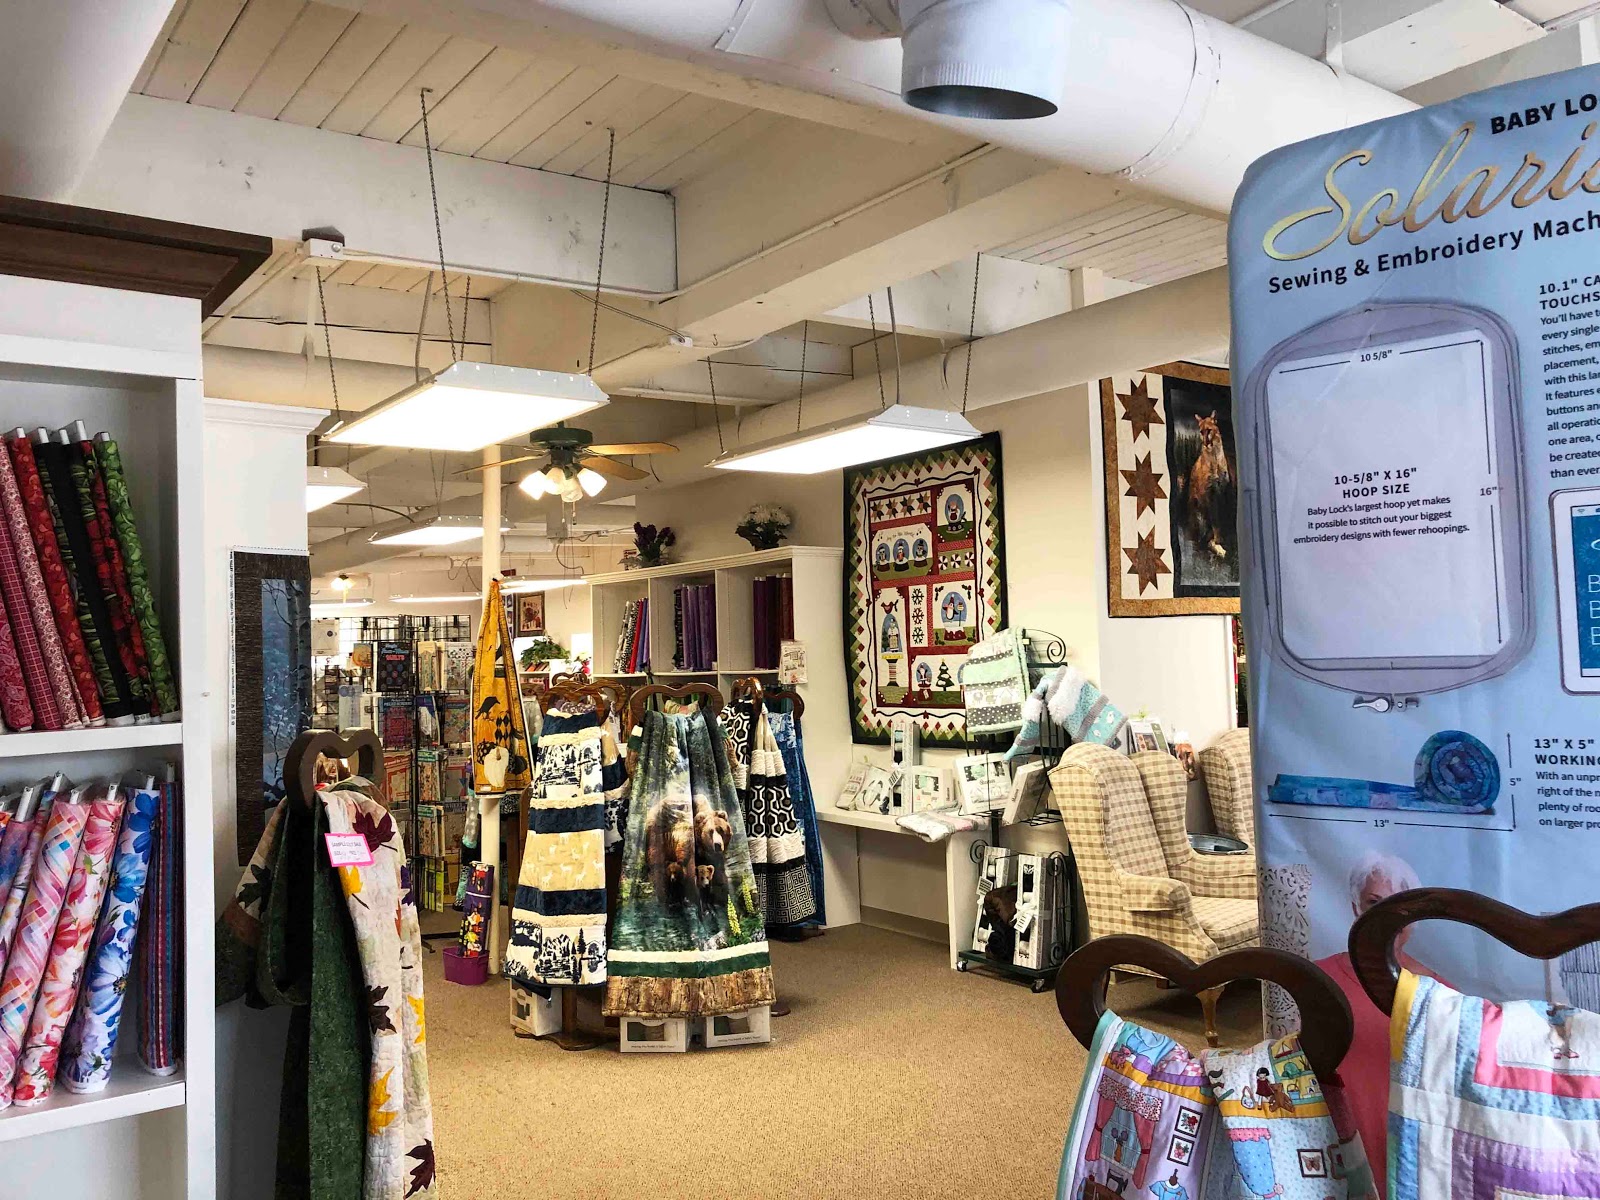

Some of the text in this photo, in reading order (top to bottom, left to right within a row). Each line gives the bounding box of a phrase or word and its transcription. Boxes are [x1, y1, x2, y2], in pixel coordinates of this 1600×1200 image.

[1490, 94, 1598, 134] BABY LO
[1269, 266, 1347, 293] Sewing
[1354, 259, 1370, 276] &
[1378, 229, 1523, 272] Embroidery
[1539, 278, 1578, 295] 10.1"
[1539, 291, 1600, 310] TOUCHS
[1540, 313, 1567, 325] You'll
[1569, 310, 1593, 321] have
[1541, 324, 1600, 340] every single
[1360, 349, 1392, 362] 10 5/8"
[1542, 343, 1583, 356] stitches,
[1543, 356, 1600, 373] placement,
[1544, 375, 1566, 385] with
[1568, 372, 1587, 382] this
[1545, 393, 1553, 401] It
[1554, 388, 1595, 400] features
[1546, 405, 1585, 416] buttons
[1547, 421, 1559, 431] all
[1548, 438, 1567, 446] one
[1569, 434, 1594, 444] area,
[1549, 453, 1563, 462] be
[1334, 467, 1417, 485] 10-5/8" X 16"
[1550, 468, 1574, 478] than
[1342, 483, 1410, 499] HOOP SIZE
[1480, 486, 1497, 496] 16"
[1307, 496, 1451, 516] Baby Lock's largest hoop yet makes
[1308, 510, 1452, 530] it possible to stitch out your biggest
[1293, 524, 1470, 544] embroidery designs with fewer rehoopings.
[1534, 738, 1595, 750] 13" X 5"
[1510, 777, 1521, 786] 5"
[1535, 771, 1559, 780] With
[1537, 786, 1561, 797] right
[1562, 787, 1573, 796] of
[1575, 787, 1593, 797] the
[1538, 801, 1570, 813] plenty
[1572, 803, 1583, 812] of
[1373, 819, 1389, 828] 13"
[1539, 818, 1552, 826] on
[1554, 817, 1584, 829] larger
